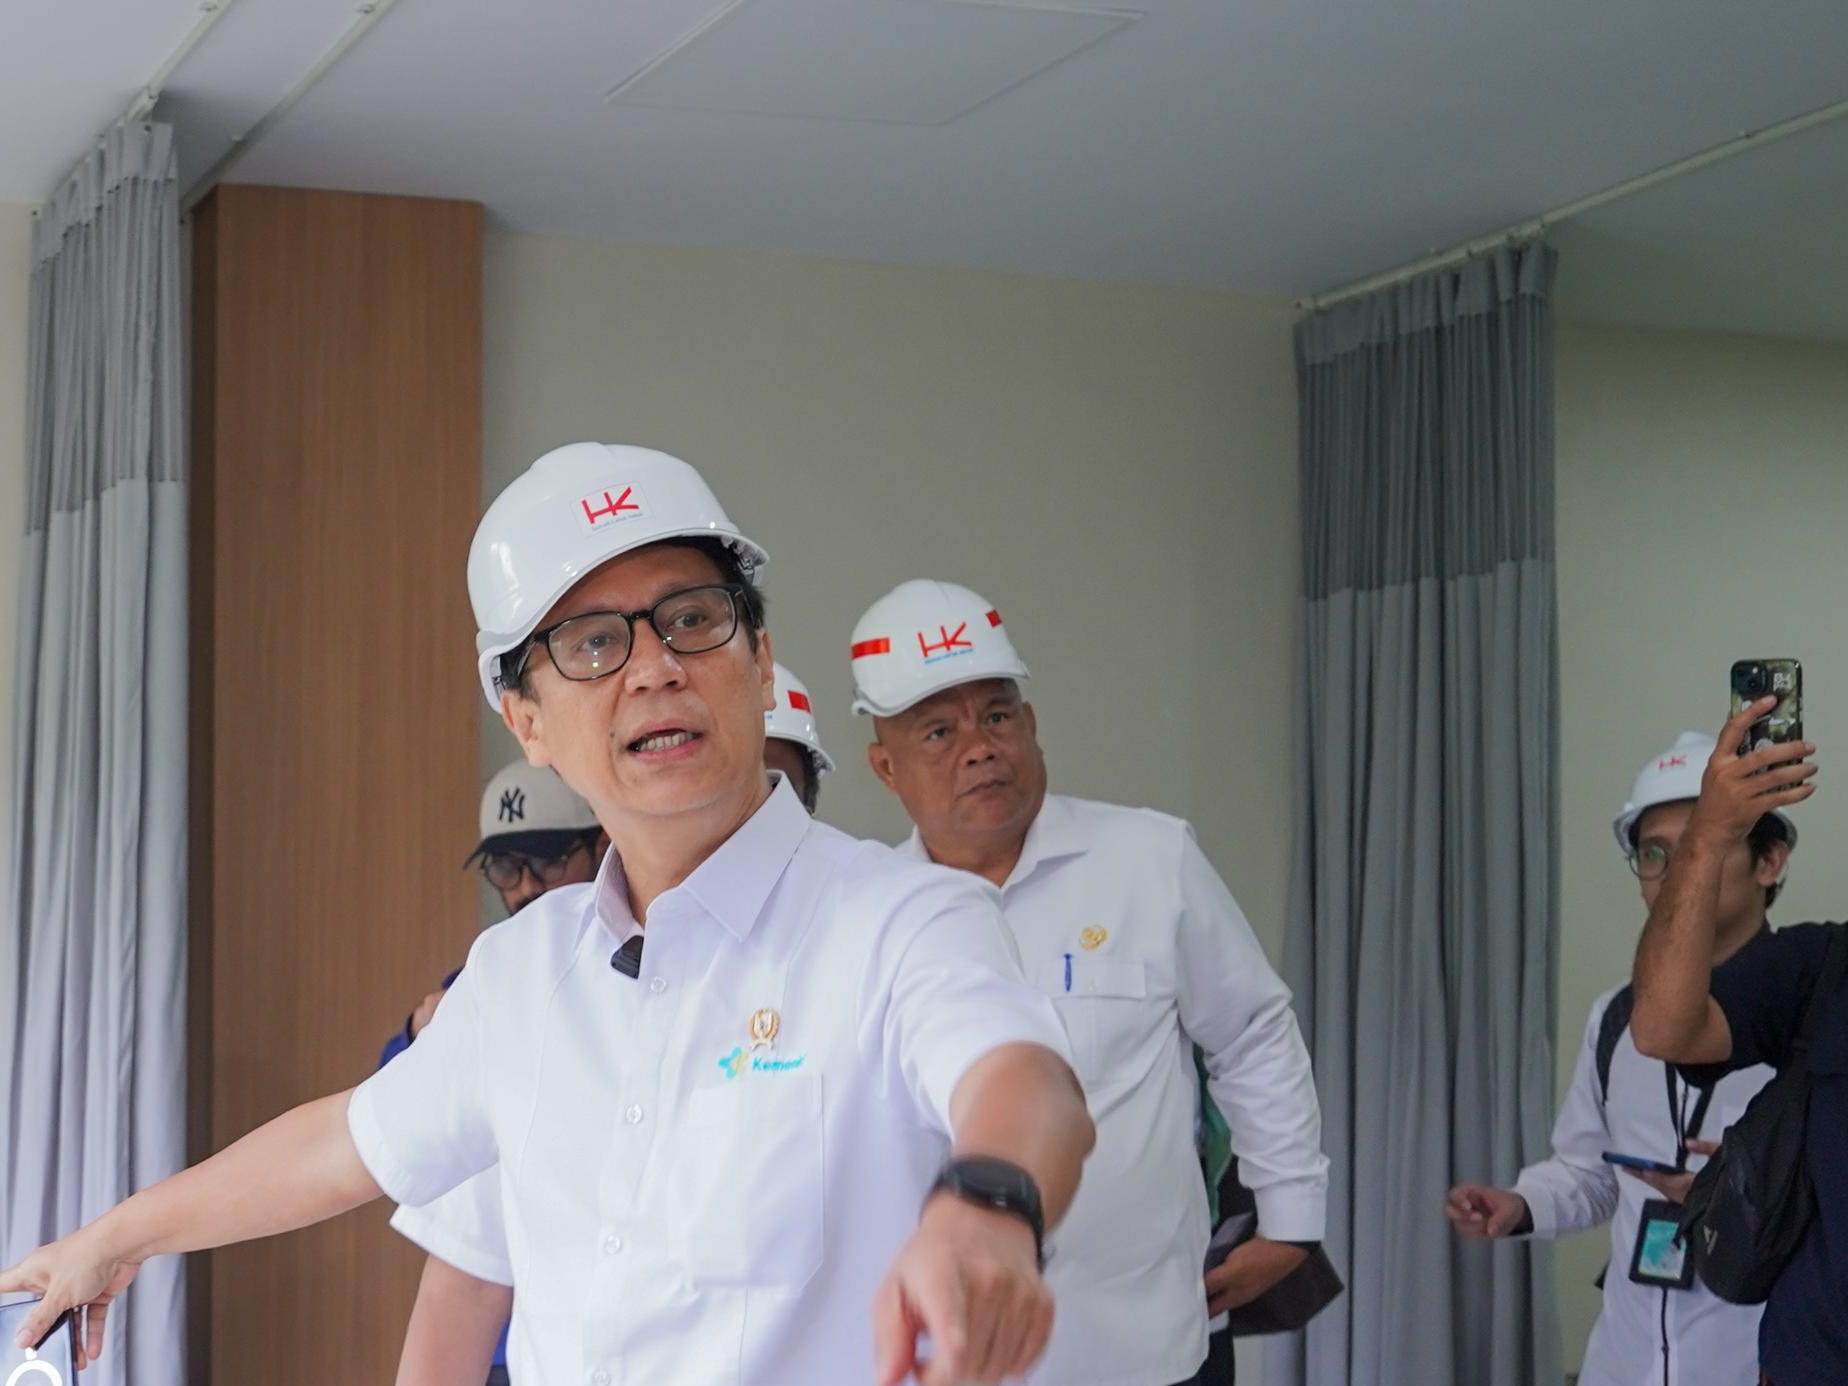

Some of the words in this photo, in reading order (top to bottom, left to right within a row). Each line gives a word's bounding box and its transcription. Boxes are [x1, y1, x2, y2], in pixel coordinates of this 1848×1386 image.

[581, 486, 640, 524] HK
[917, 621, 972, 659] HK
[498, 787, 526, 823] NY
